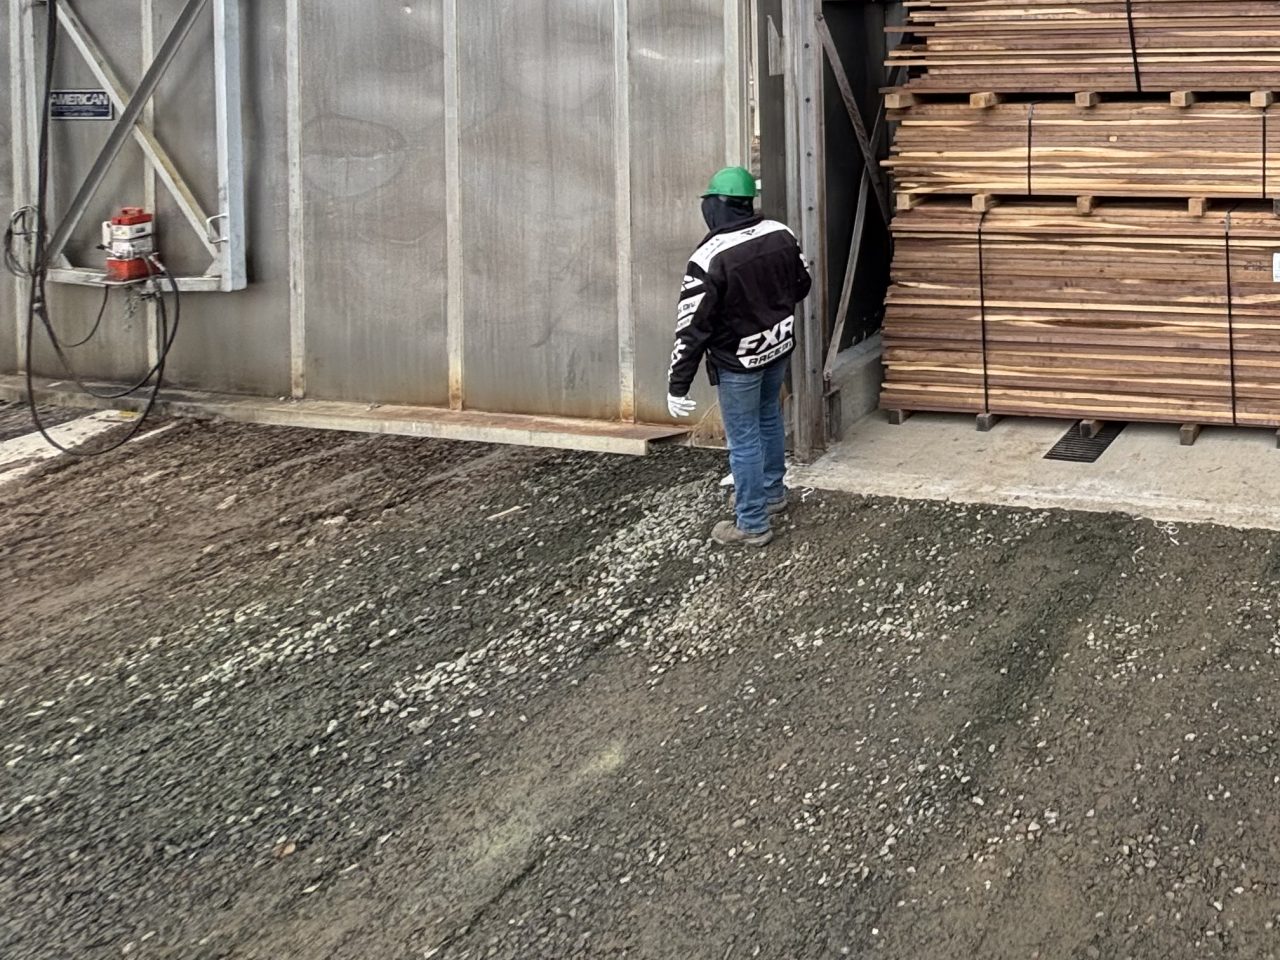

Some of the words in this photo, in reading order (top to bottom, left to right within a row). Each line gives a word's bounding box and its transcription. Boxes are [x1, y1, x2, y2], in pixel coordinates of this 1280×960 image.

[50, 93, 108, 105] AMERICAN
[736, 315, 794, 355] FXR
[748, 346, 782, 366] RACE
